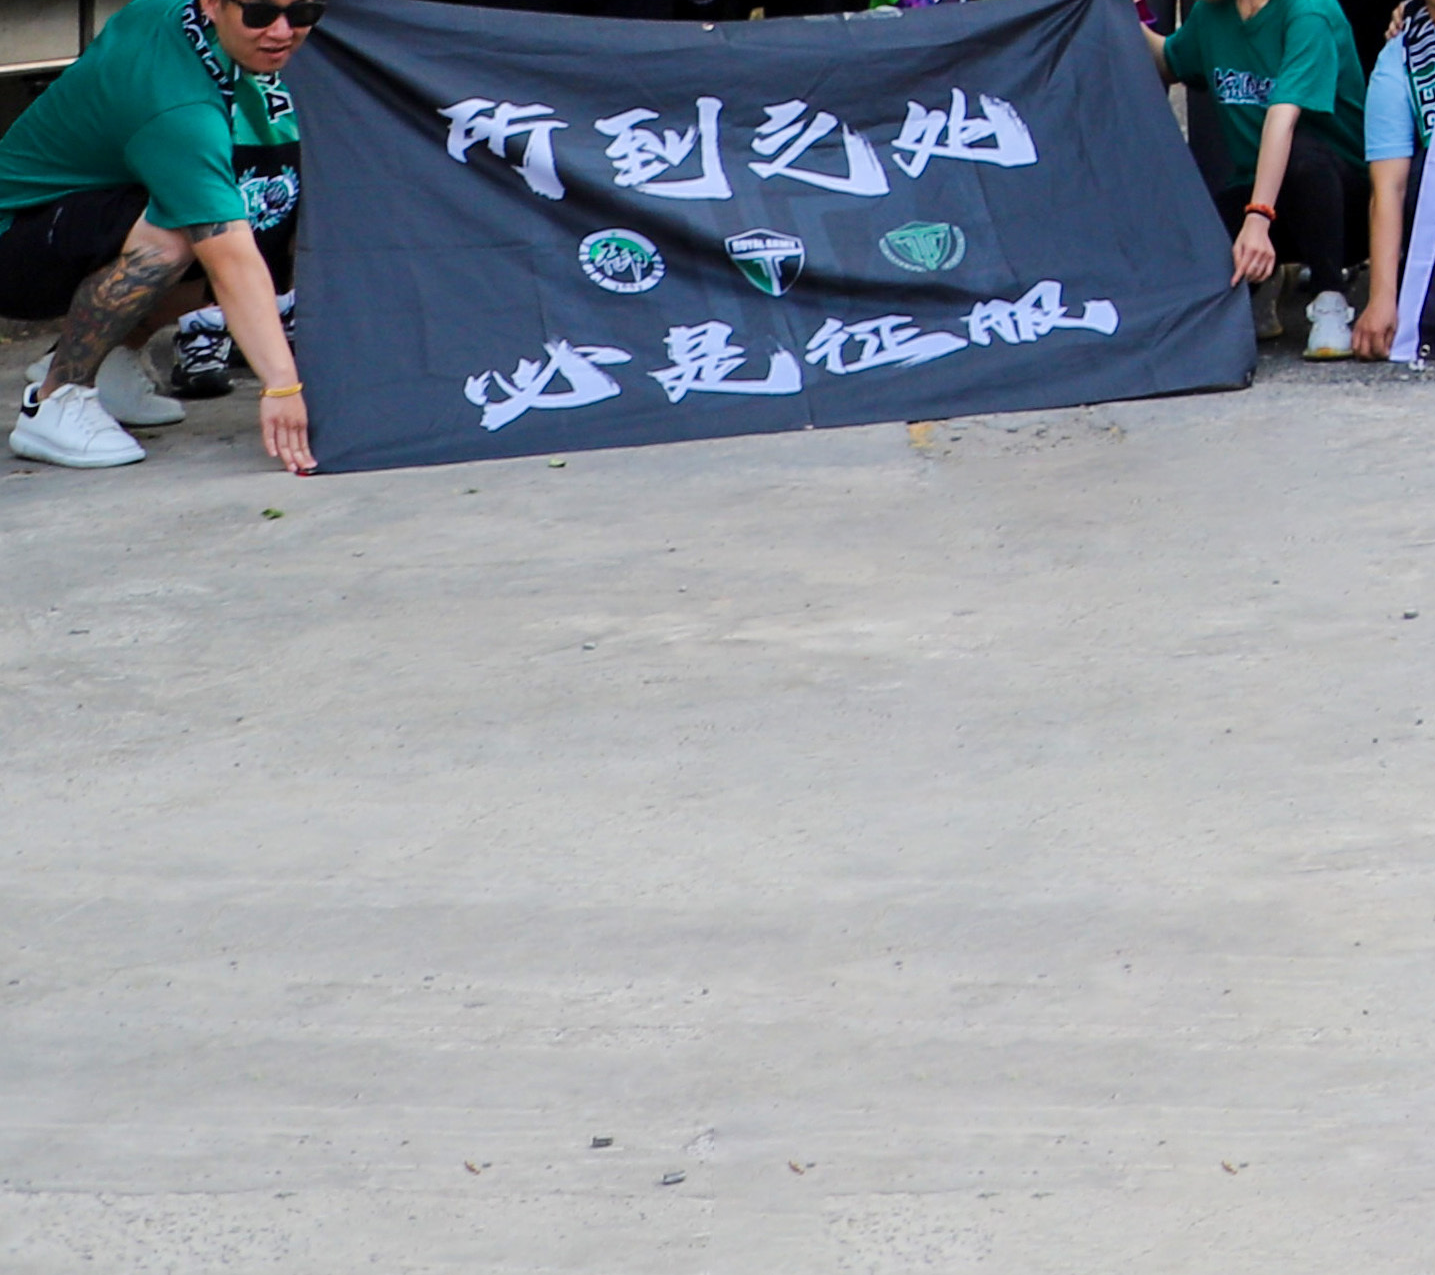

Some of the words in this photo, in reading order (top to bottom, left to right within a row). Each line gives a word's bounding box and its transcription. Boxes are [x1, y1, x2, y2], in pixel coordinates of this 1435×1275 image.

[438, 87, 1038, 201] 所到之处
[463, 280, 1119, 432] 必是征服
